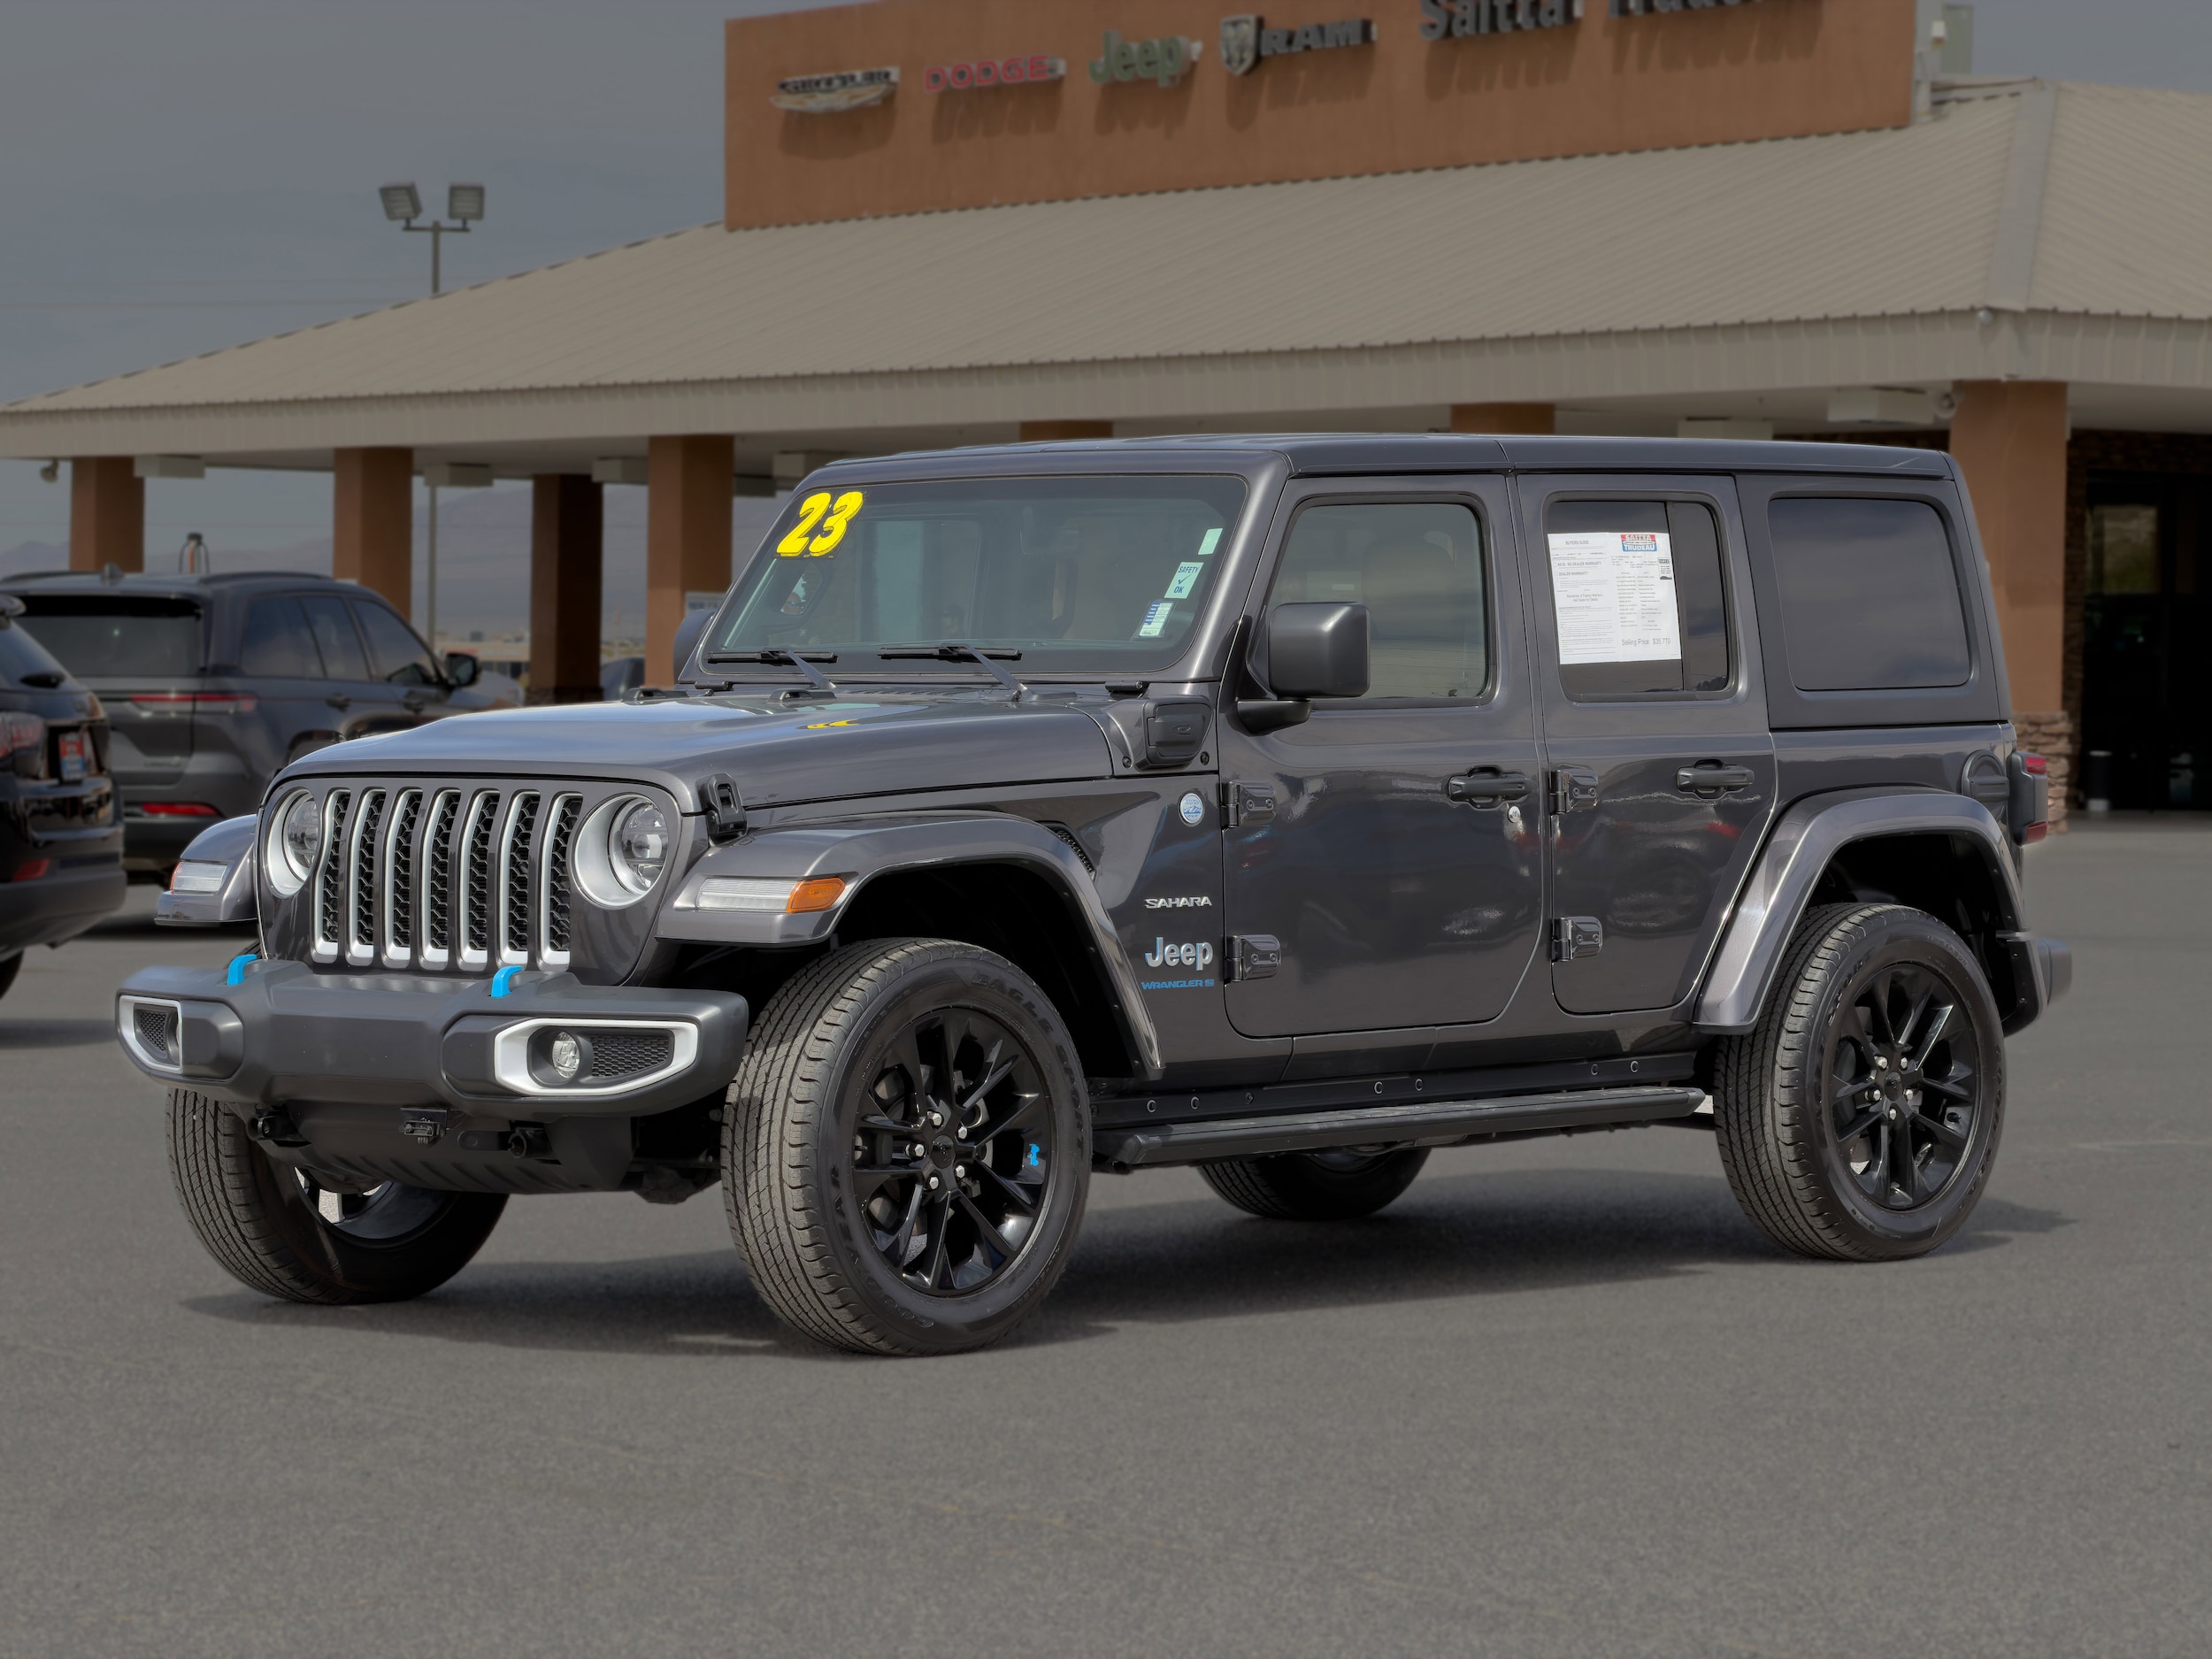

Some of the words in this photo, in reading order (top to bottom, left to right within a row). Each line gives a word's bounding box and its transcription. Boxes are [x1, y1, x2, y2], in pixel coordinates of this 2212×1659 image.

[1260, 19, 1367, 56] RAM
[1419, 0, 1566, 41] Saitta
[925, 54, 1053, 92] DODGE
[1088, 29, 1186, 88] Jeep
[777, 491, 864, 557] 23
[1622, 638, 1637, 647] Selling
[1144, 896, 1213, 909] SAHARA
[1145, 937, 1213, 971] Jeep
[1141, 979, 1203, 989] WRANGLER
